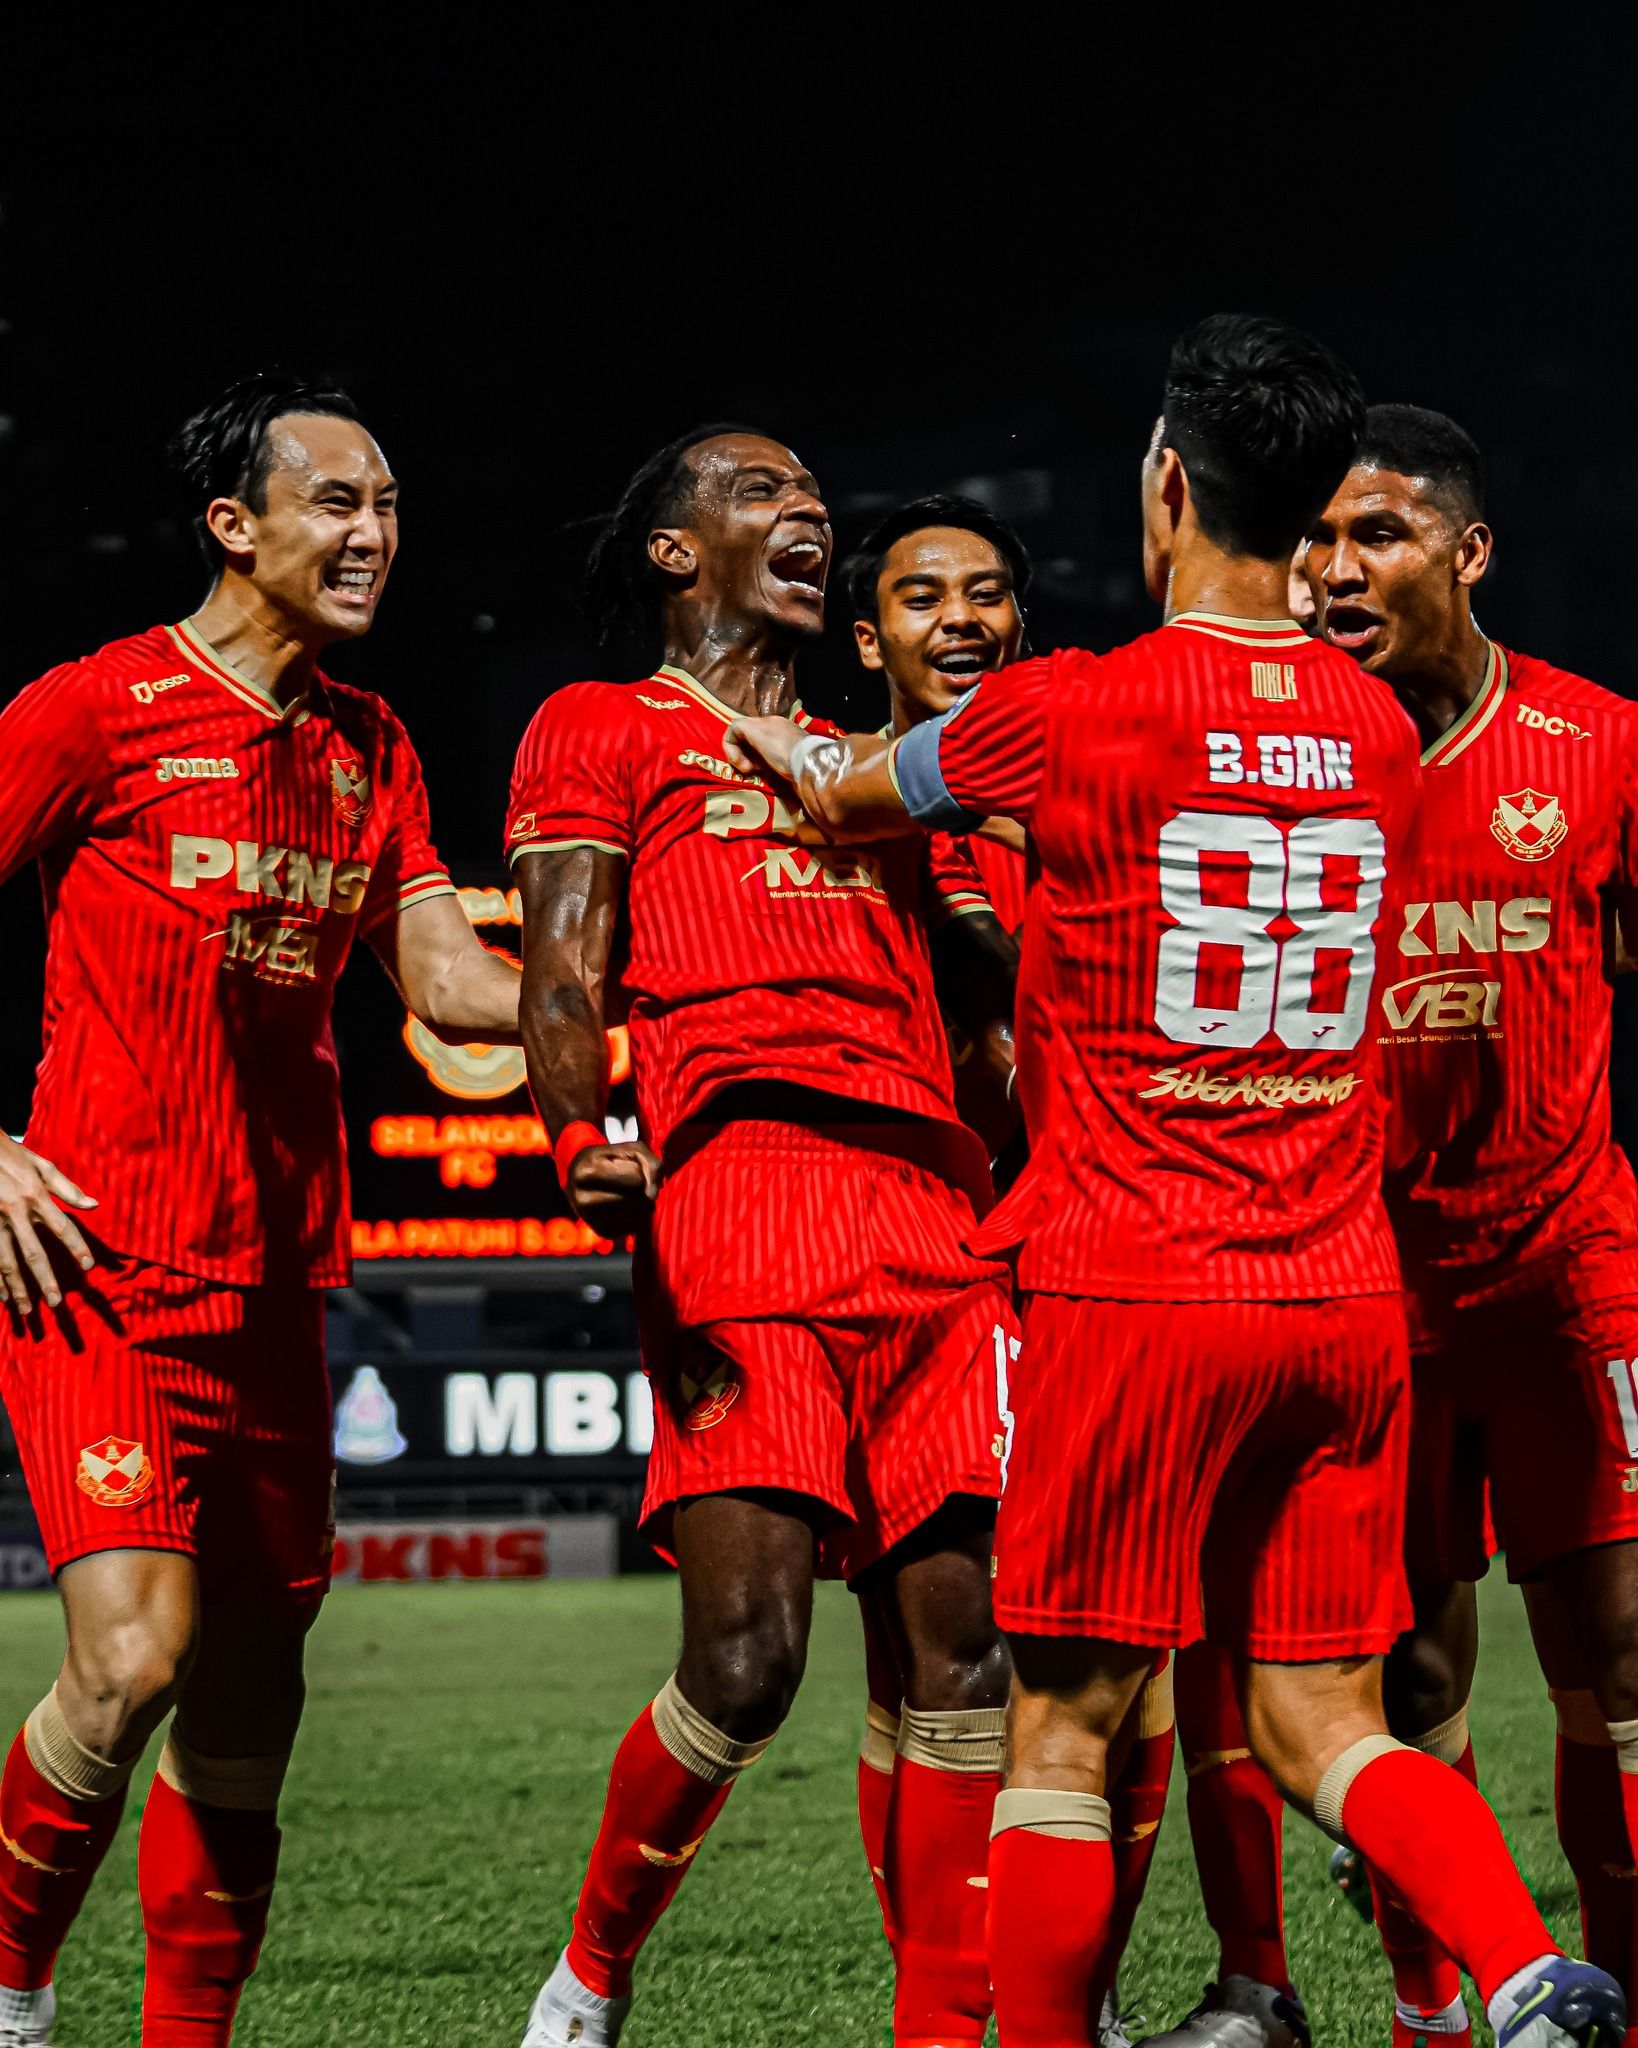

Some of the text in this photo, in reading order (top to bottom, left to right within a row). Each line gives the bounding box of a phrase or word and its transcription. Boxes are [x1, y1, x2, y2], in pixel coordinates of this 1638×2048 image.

[1205, 732, 1354, 790] B.GAN
[170, 833, 371, 914] PKNS
[1154, 812, 1388, 1050] 88
[1398, 897, 1551, 957] KNS
[446, 1371, 654, 1457] MBI
